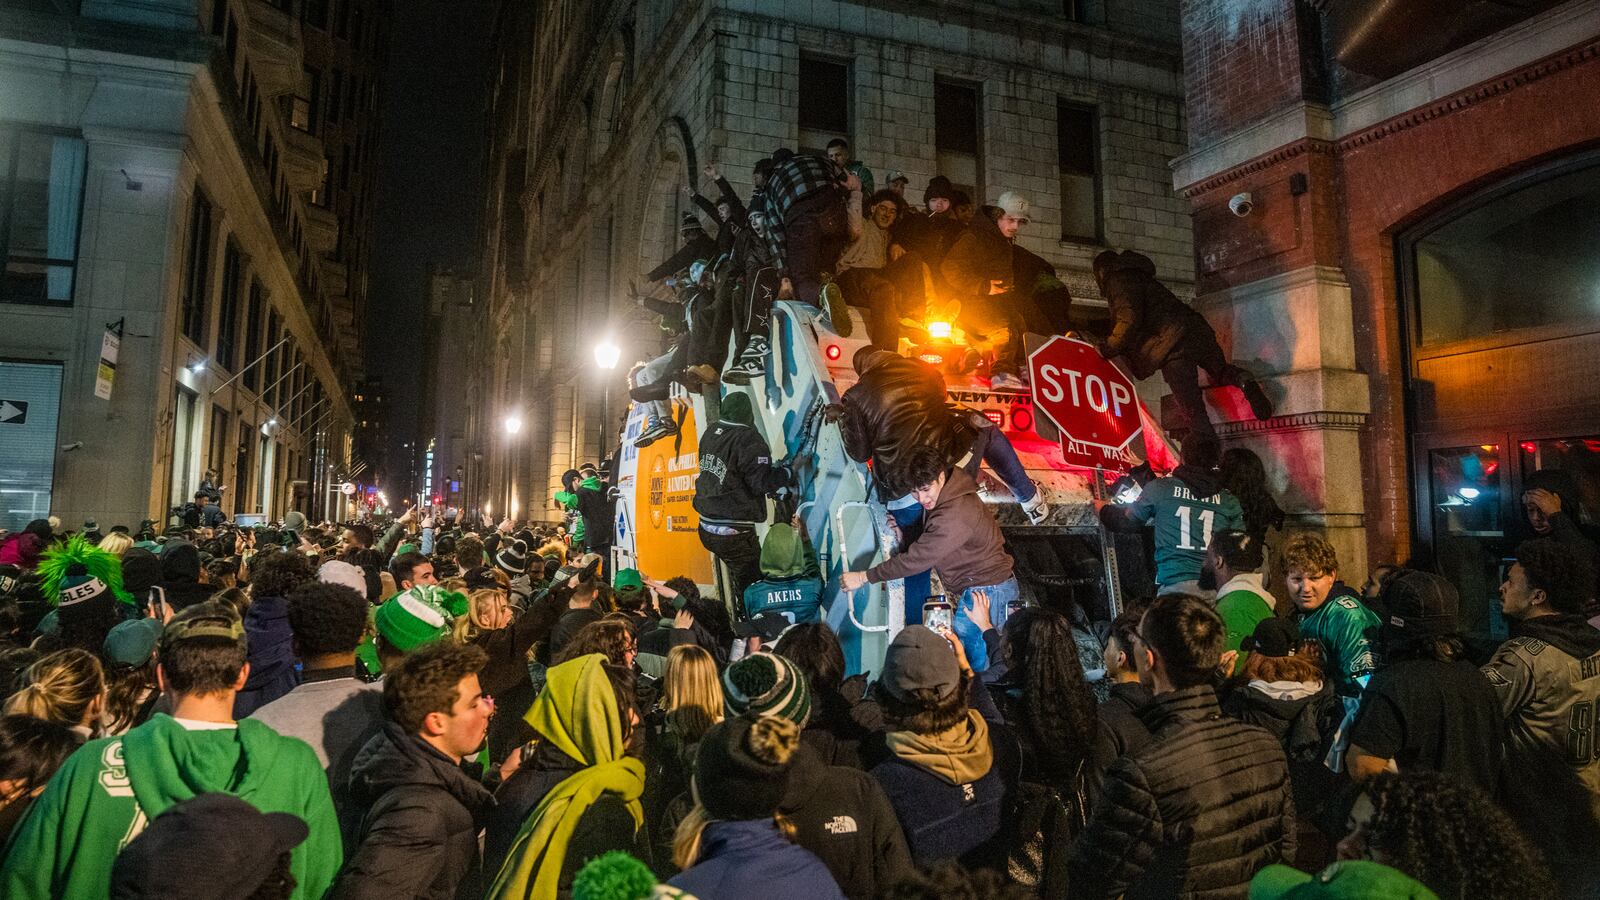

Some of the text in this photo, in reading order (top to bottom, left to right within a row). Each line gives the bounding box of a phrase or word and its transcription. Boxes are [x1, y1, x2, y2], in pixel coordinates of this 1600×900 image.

[947, 391, 989, 403] NEW
[1040, 363, 1131, 418] STOP
[1067, 441, 1092, 456] ALL
[699, 453, 728, 485] AGLES
[1173, 486, 1221, 505] BRN
[1174, 505, 1215, 551] 11
[60, 584, 95, 603] GLES
[767, 589, 802, 604] AKERS
[1567, 699, 1600, 764] 8
